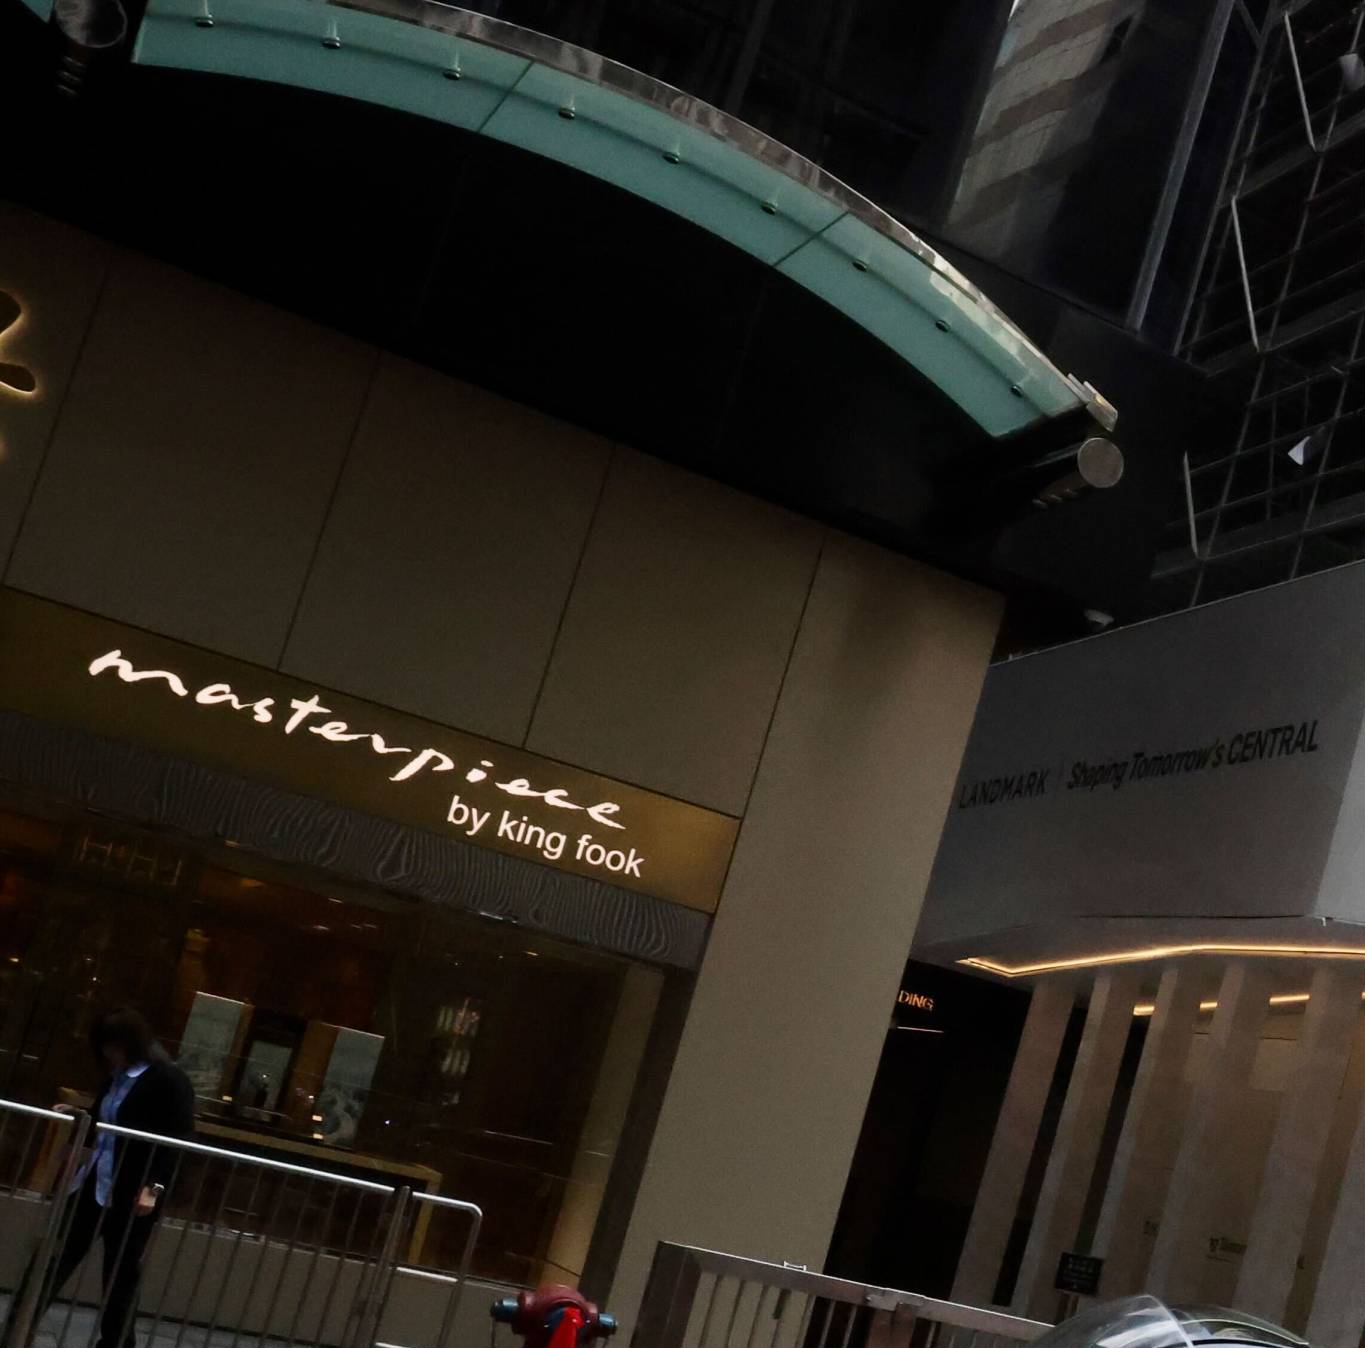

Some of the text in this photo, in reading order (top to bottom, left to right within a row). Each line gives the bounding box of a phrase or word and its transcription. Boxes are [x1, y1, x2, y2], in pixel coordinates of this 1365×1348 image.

[88, 648, 627, 831] masterpiece
[958, 769, 1050, 810] LANDMARK
[1067, 760, 1129, 792] Shaping
[1227, 719, 1320, 766] CENTRAL
[447, 795, 645, 878] by king fook
